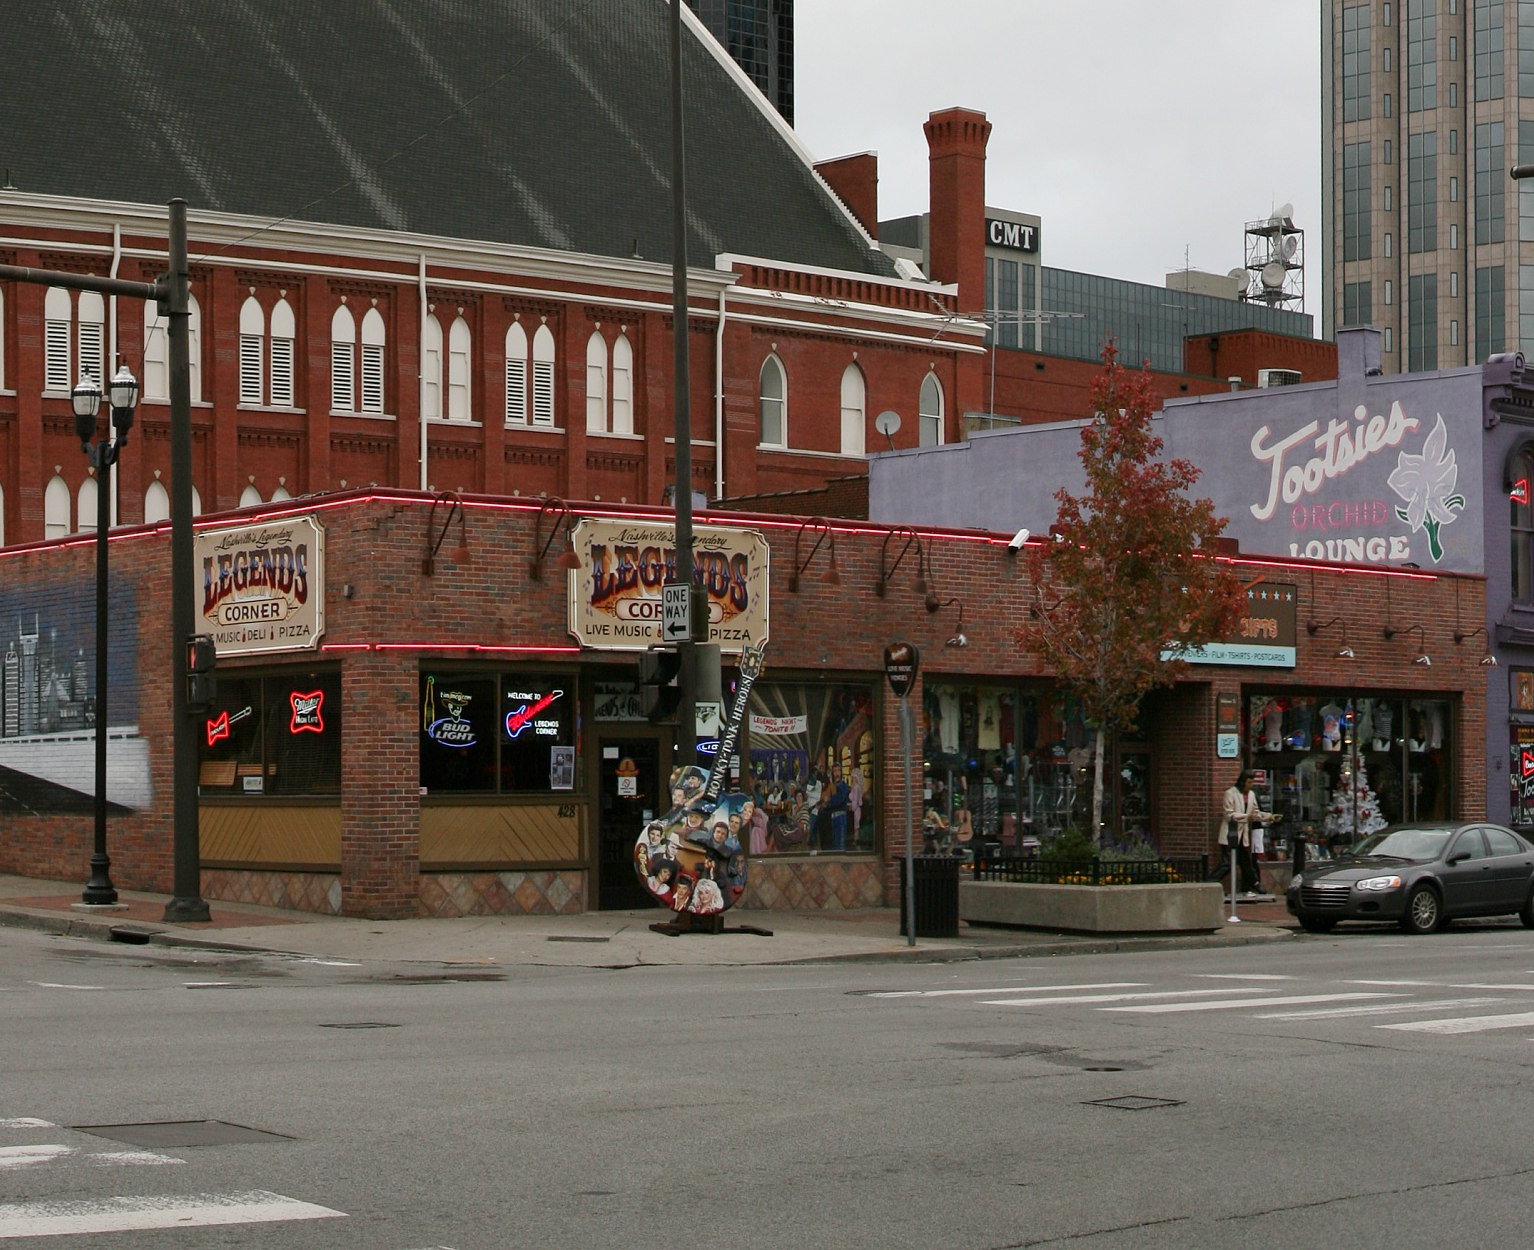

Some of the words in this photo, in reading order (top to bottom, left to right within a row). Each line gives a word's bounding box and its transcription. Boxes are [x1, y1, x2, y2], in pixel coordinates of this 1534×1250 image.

[990, 220, 1033, 249] CMT
[1250, 400, 1419, 520] Tootsies
[1289, 500, 1389, 532] ORCHID
[1289, 535, 1411, 562] LOUNGE
[203, 544, 308, 616] LEGENDS
[666, 589, 687, 602] ONE
[225, 602, 280, 622] CORNER
[666, 605, 688, 619] WAY
[216, 631, 241, 644] MUSIC
[248, 629, 266, 641] DELI
[279, 625, 310, 638] PIZZA
[586, 624, 610, 636] LIVE
[614, 625, 652, 638] MUSIC
[710, 628, 751, 641] PIZZA
[1211, 651, 1225, 659] FILM
[1228, 652, 1251, 660] TSHIRTS
[1253, 653, 1286, 662] POSTCARDS
[507, 692, 533, 700] WELCOME
[442, 723, 471, 732] BUD
[534, 720, 560, 728] LEGENDS
[753, 716, 778, 726] LEGENDS
[435, 731, 476, 741] LIGHT
[764, 725, 789, 733] TONITE
[707, 723, 739, 798] HONKY-TONK
[731, 679, 752, 721] HEROES
[557, 805, 576, 818] 428
